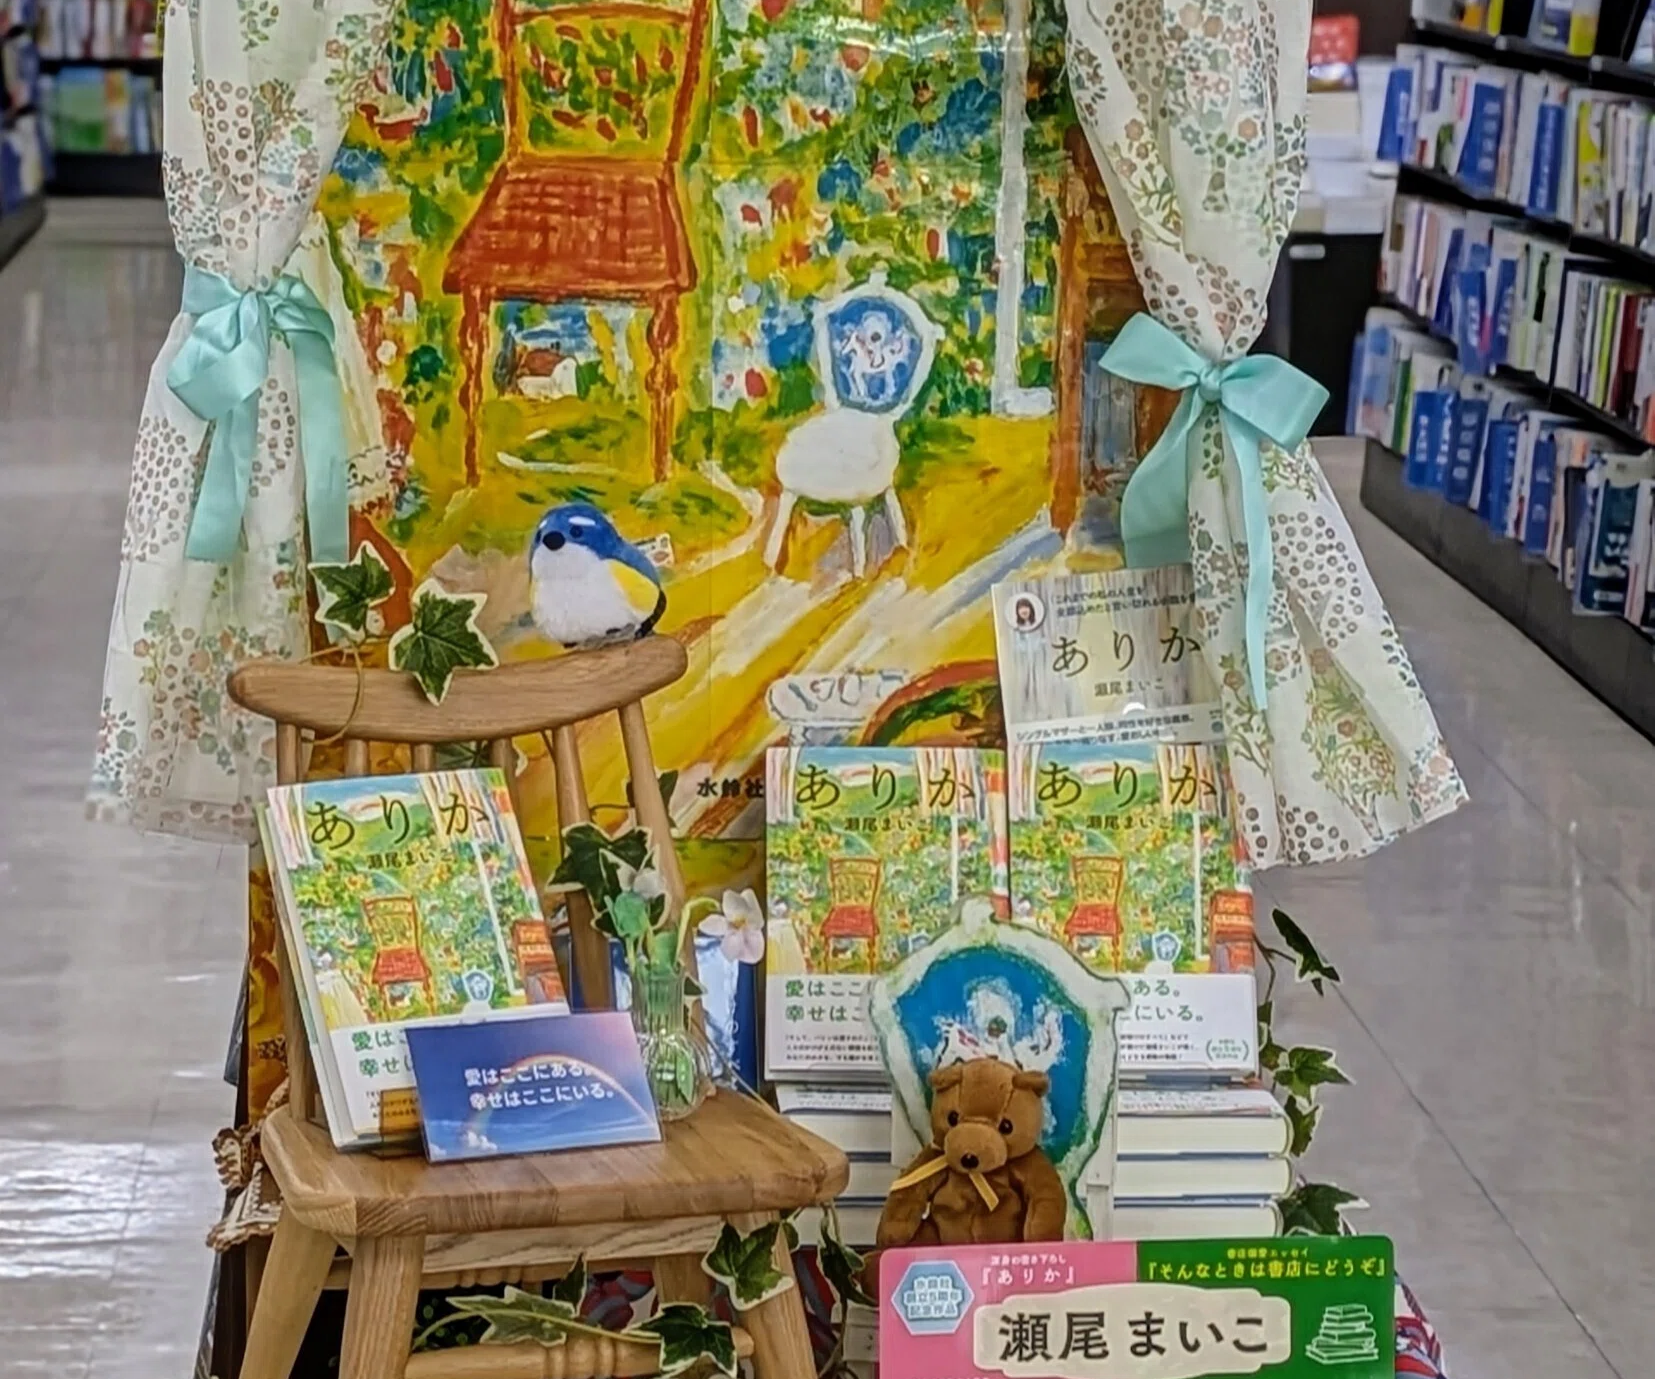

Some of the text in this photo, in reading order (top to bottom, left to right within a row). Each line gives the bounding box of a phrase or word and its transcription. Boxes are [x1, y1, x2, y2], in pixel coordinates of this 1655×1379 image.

[1051, 626, 1200, 677] ありか
[1094, 677, 1165, 697] 瀬尾まいこ
[696, 777, 765, 798] 水鈴社
[796, 763, 976, 811] ありか
[1038, 761, 1217, 809] ありか
[306, 792, 490, 851] ありか
[463, 1061, 593, 1087] 愛はここにある。
[469, 1082, 615, 1111] 幸せはここにいる。
[998, 1311, 1268, 1362] 瀬尾まいこ
